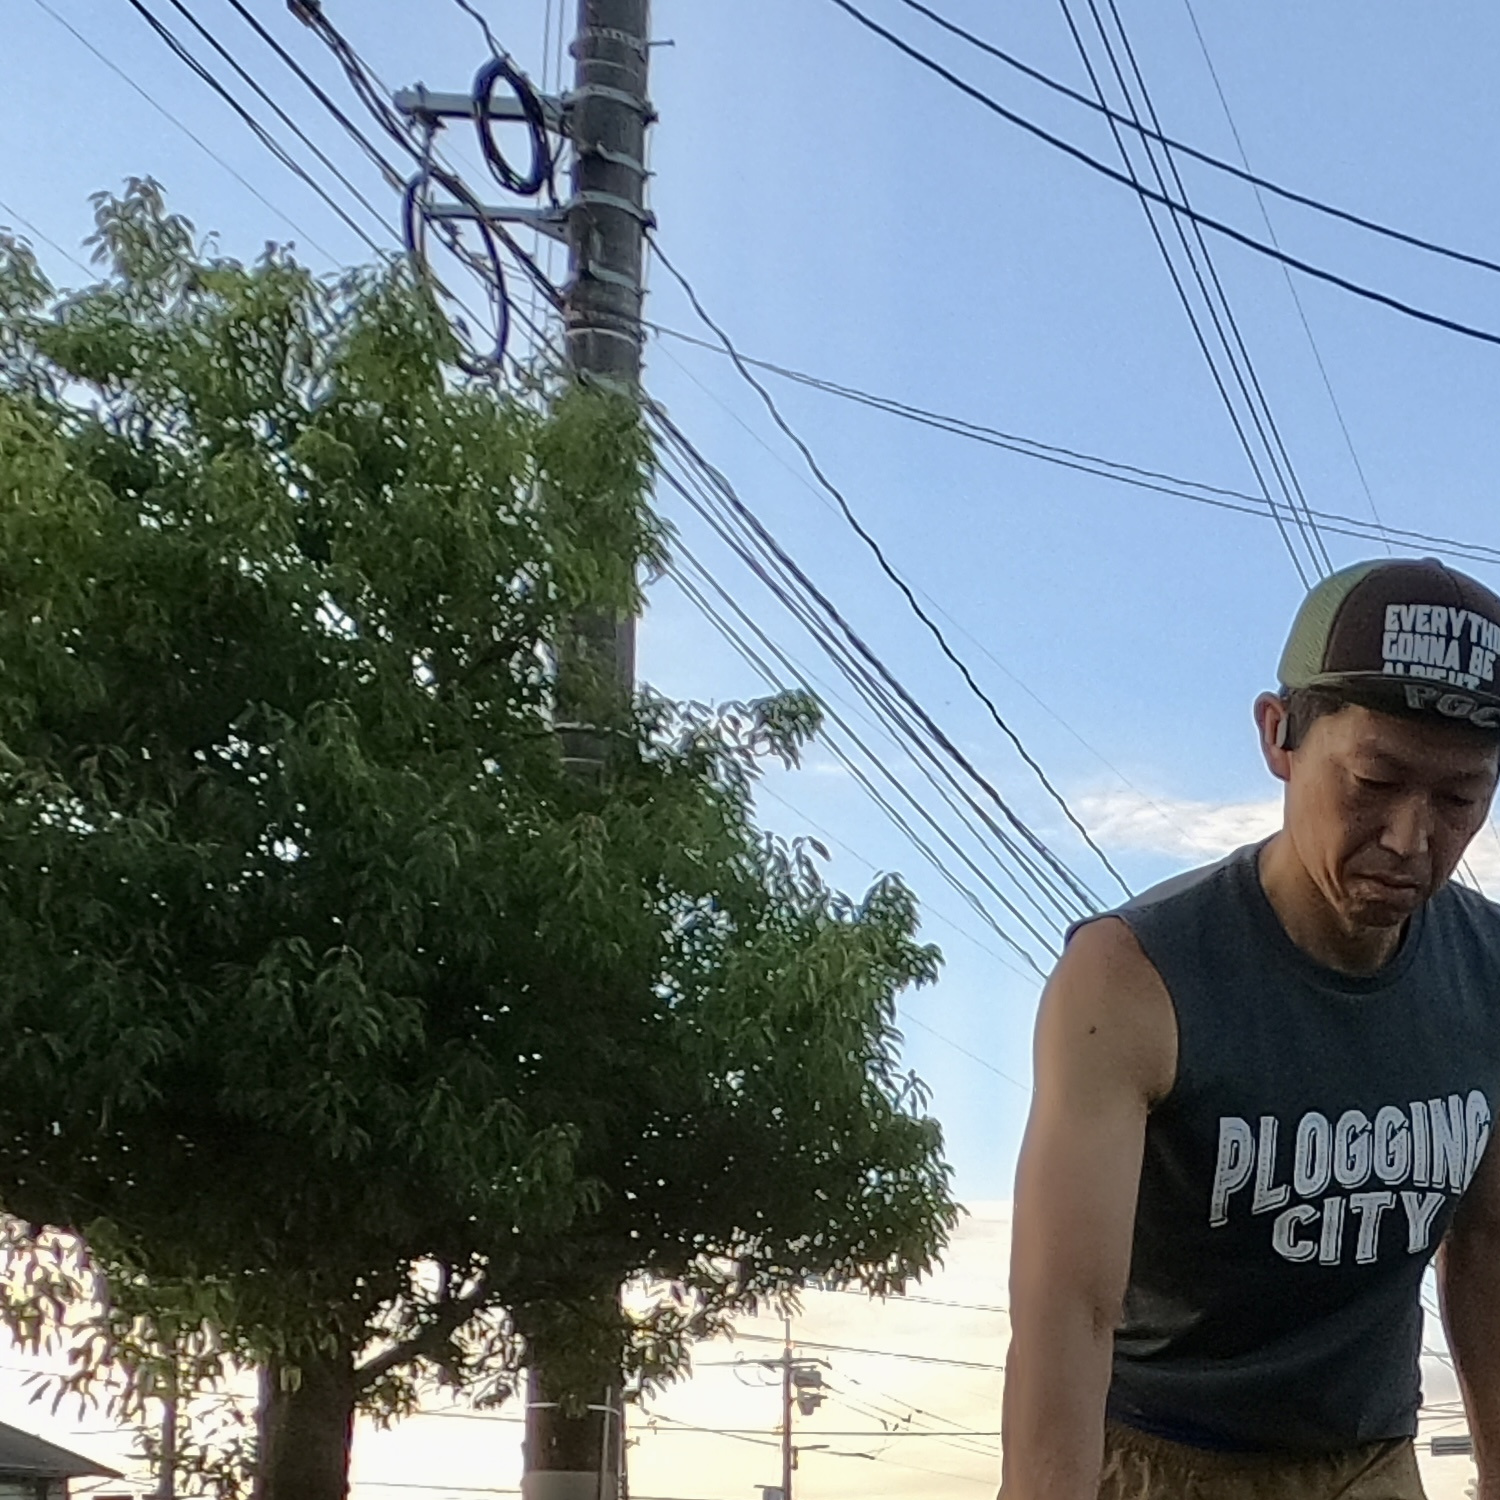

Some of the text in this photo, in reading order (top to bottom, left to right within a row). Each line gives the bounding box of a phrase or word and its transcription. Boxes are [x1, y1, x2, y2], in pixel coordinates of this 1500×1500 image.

[1382, 631, 1496, 682] GONNA BE
[1209, 1089, 1491, 1228] PLOGGING
[1271, 1190, 1446, 1266] CITY
